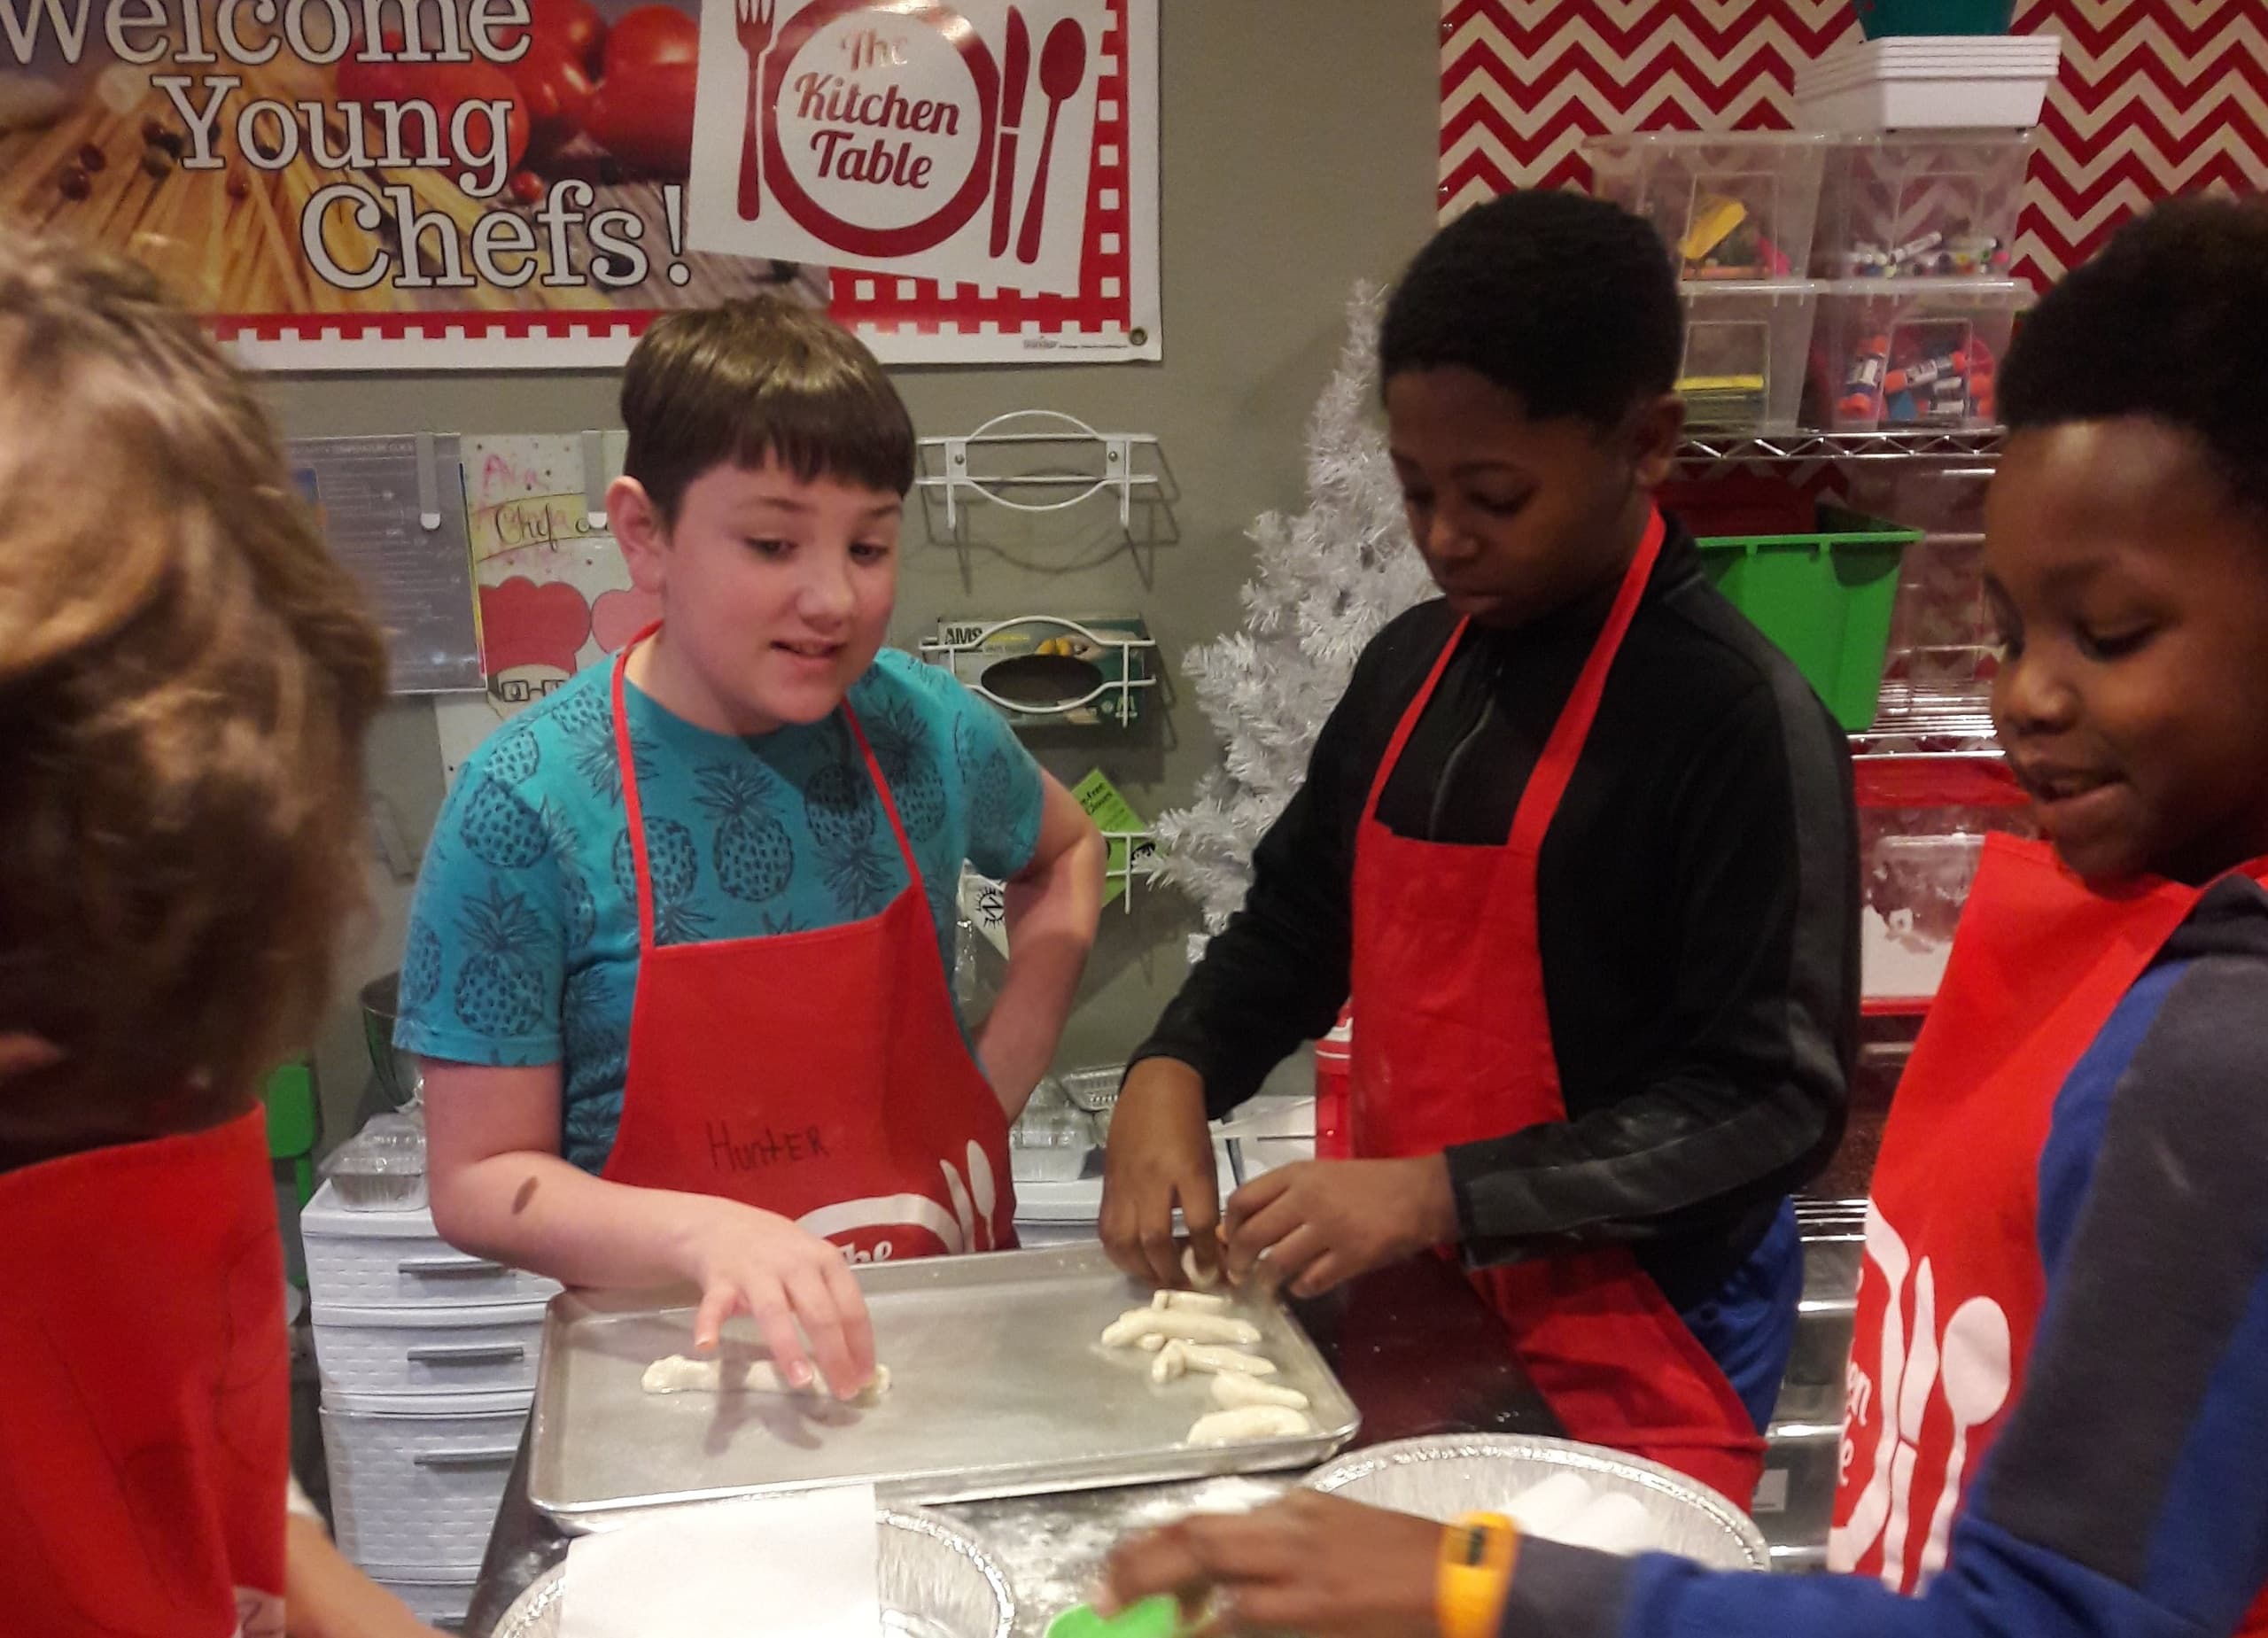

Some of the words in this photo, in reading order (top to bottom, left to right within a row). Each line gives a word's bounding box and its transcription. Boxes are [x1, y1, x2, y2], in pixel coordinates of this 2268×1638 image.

[0, 0, 532, 64] Welcome
[151, 75, 513, 197] Young
[795, 71, 960, 136] Kitchen
[810, 128, 933, 190] Table
[301, 179, 691, 290] Chefs!
